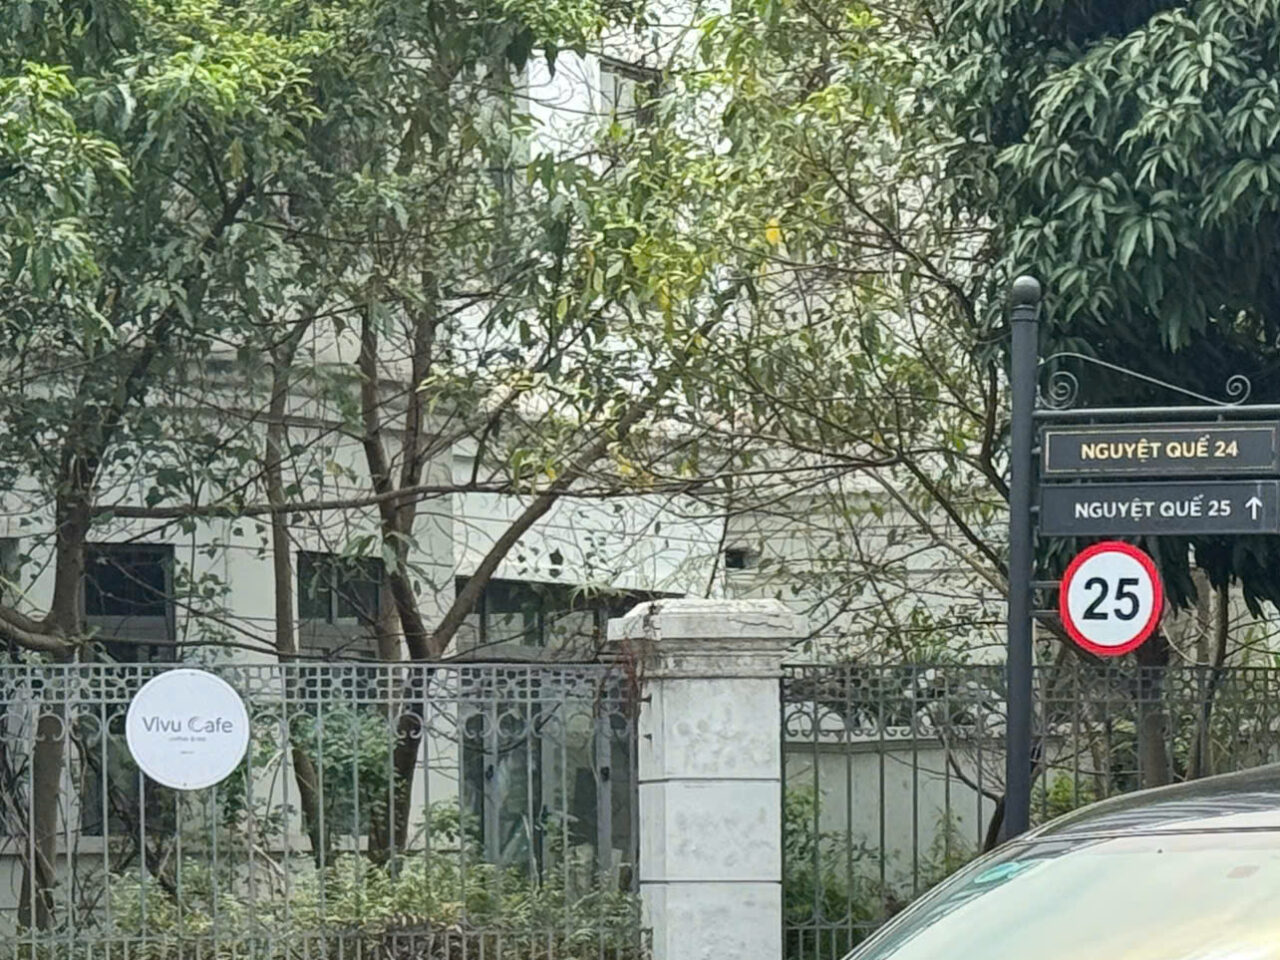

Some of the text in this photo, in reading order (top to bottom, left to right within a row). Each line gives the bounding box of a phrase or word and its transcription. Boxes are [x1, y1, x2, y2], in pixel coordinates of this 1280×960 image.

[1080, 434, 1239, 462] NGUYỆT QUẾ 24
[1074, 494, 1231, 522] NGUYỆT QUẾ 25
[1082, 576, 1141, 621] 25
[141, 715, 234, 733] Vivu Cafe
